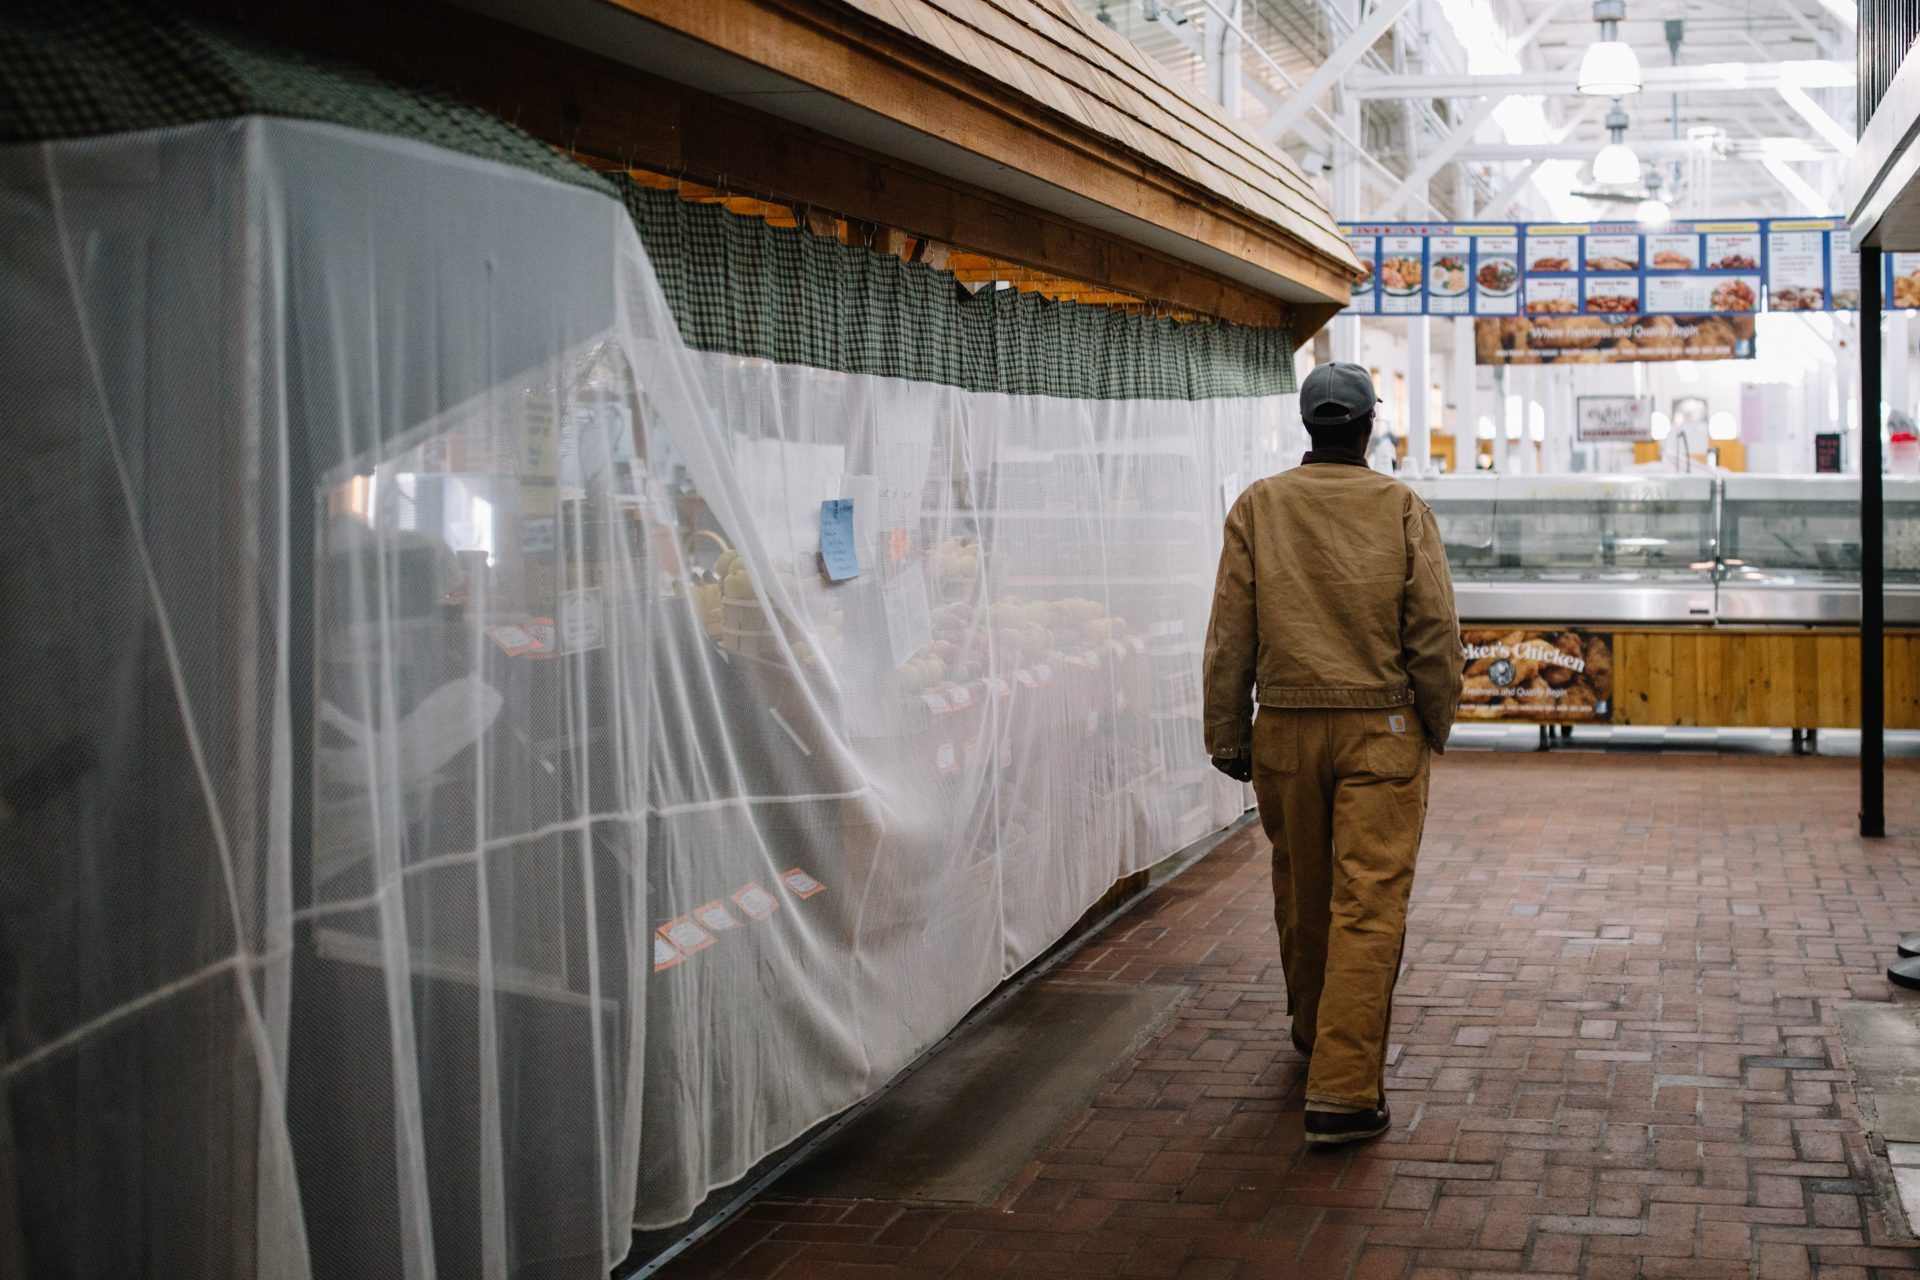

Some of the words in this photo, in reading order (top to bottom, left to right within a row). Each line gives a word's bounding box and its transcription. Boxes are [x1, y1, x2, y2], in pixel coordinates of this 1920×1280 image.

[1530, 327, 1564, 338] Where
[1567, 325, 1612, 337] Freshness
[1614, 325, 1632, 337] and
[1634, 324, 1669, 339] Quality
[1513, 642, 1586, 673] Chicken
[1501, 687, 1515, 697] and
[1516, 687, 1545, 699] Quality
